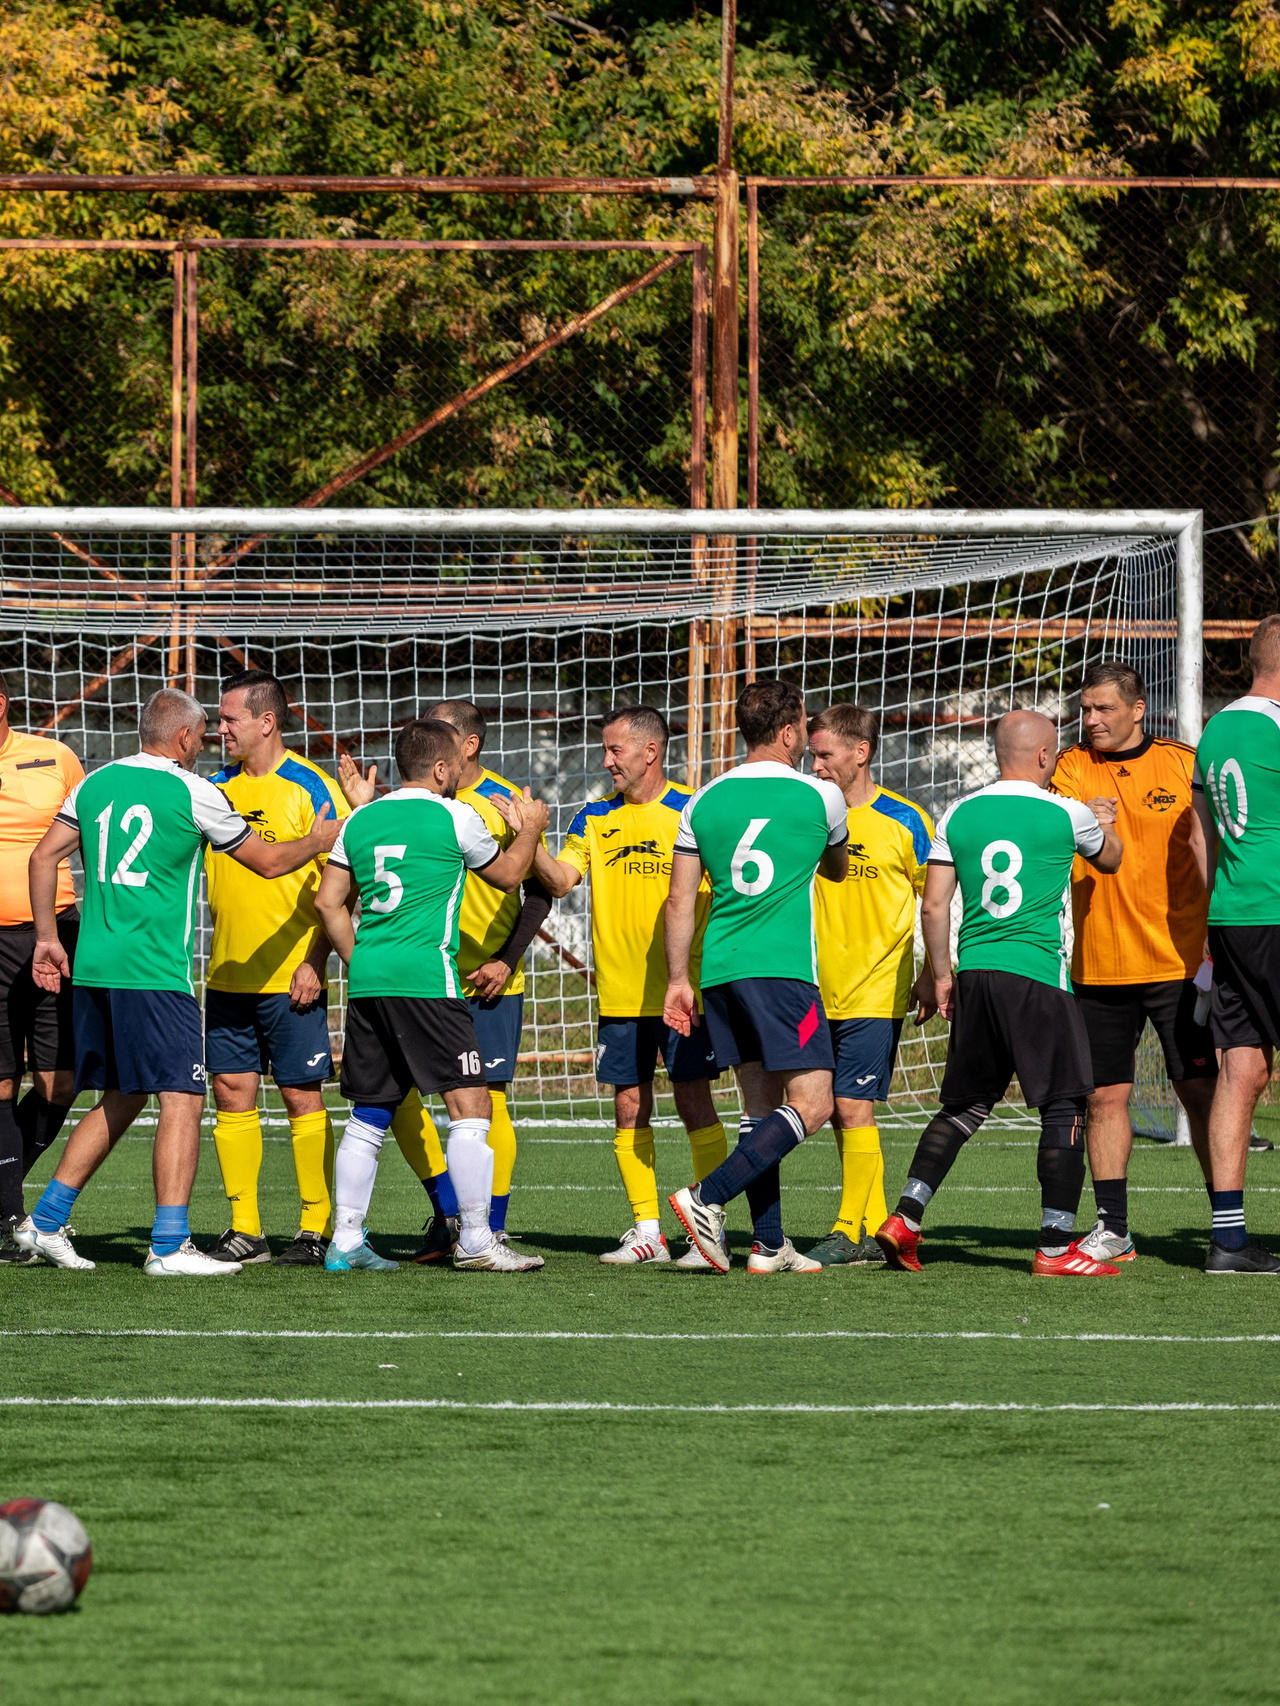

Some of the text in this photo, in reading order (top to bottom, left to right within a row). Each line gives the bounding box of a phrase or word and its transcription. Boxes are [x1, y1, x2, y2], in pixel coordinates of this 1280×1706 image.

[1206, 758, 1248, 839] 10
[94, 800, 154, 888] 12
[370, 844, 408, 914] 5
[624, 861, 673, 876] IRBIS
[730, 818, 775, 897] 6
[847, 863, 879, 879] BIS
[980, 839, 1023, 919] 8
[192, 1063, 206, 1082] 29
[457, 1050, 481, 1076] 16
